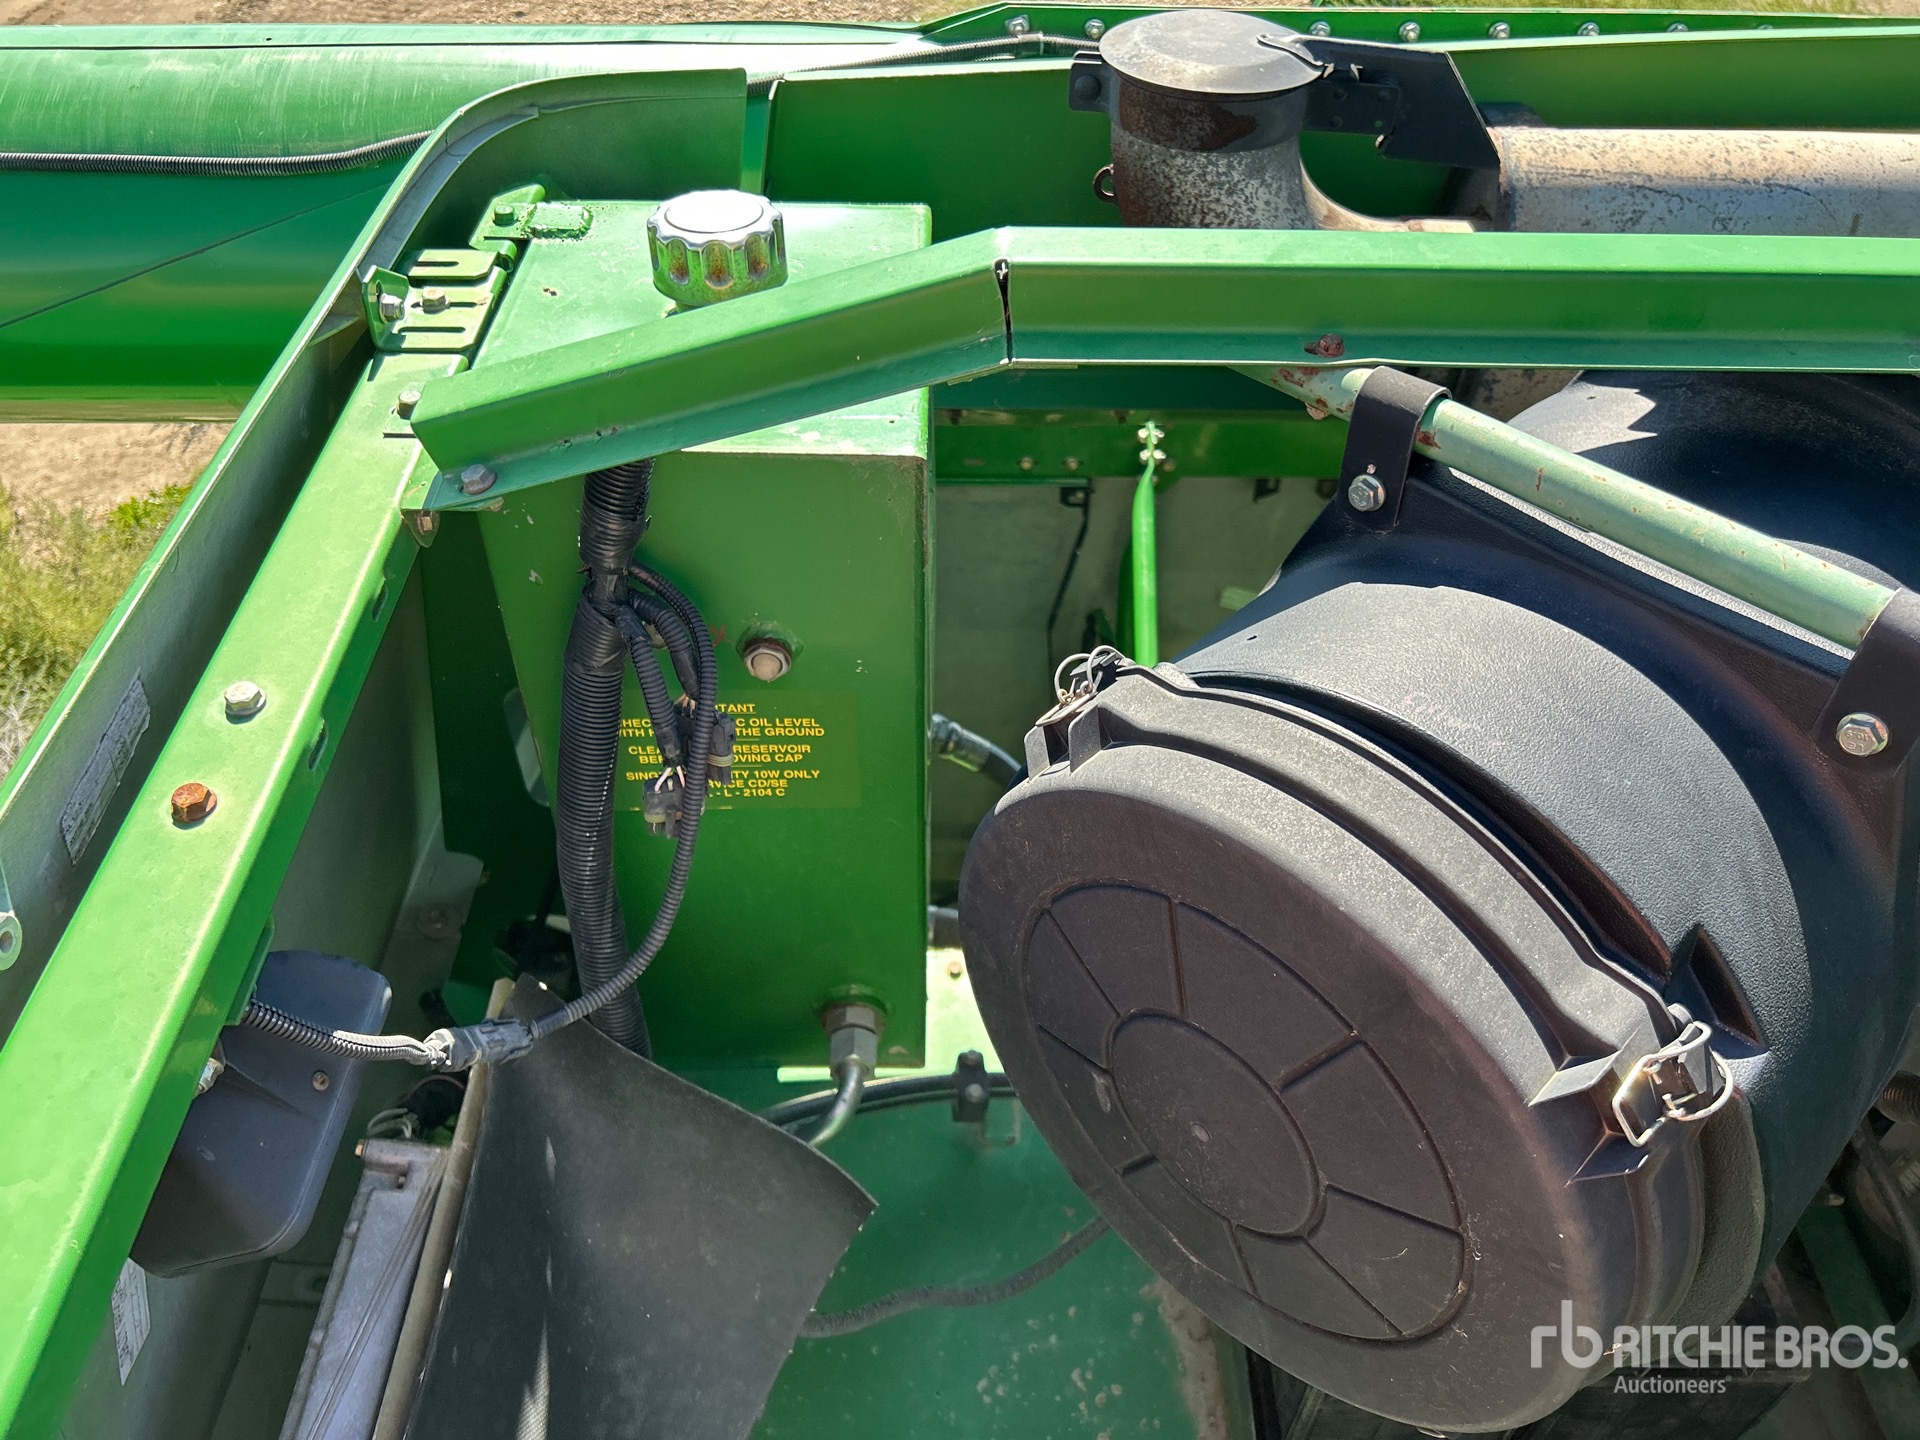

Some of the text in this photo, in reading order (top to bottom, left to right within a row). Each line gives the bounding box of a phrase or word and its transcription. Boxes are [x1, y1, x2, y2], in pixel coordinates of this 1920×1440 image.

[749, 719, 773, 727] OIL
[776, 719, 819, 727] LEVEL
[735, 728, 761, 737] THE
[765, 728, 825, 737] GROUND
[733, 745, 811, 754] RESERVOIR
[775, 754, 803, 762] CAP
[754, 770, 779, 778] 10W
[783, 770, 820, 778] ONLY
[748, 779, 788, 788] CD/SE
[743, 789, 773, 797] 2104
[776, 788, 786, 796] C
